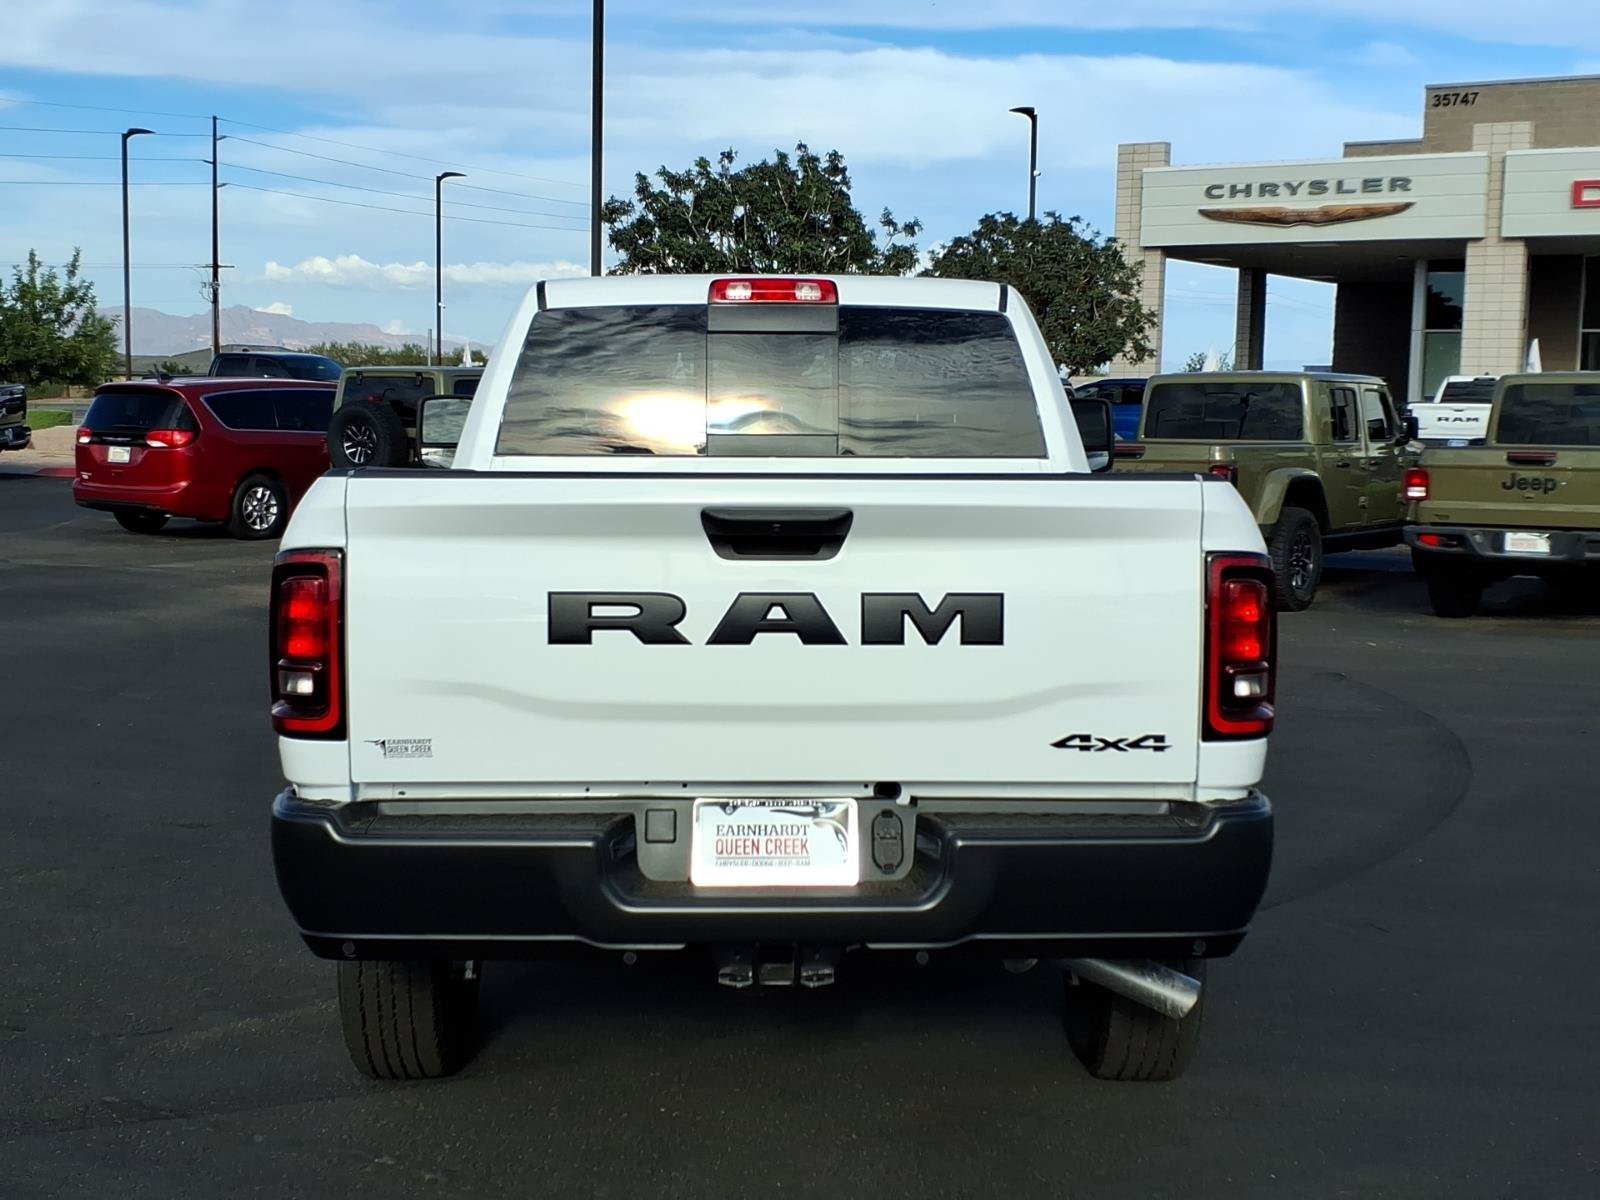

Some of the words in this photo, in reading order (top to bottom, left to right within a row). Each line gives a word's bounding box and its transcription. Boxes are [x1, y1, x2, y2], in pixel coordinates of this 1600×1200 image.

[1432, 91, 1479, 107] 35747
[1204, 176, 1413, 200] CHRYSLER
[1502, 473, 1557, 494] Jeep
[547, 591, 1005, 645] RAM
[1050, 734, 1172, 752] 4x4
[716, 824, 810, 837] EARNHARDT
[715, 838, 760, 856] QUEEN
[765, 838, 809, 855] CREEK
